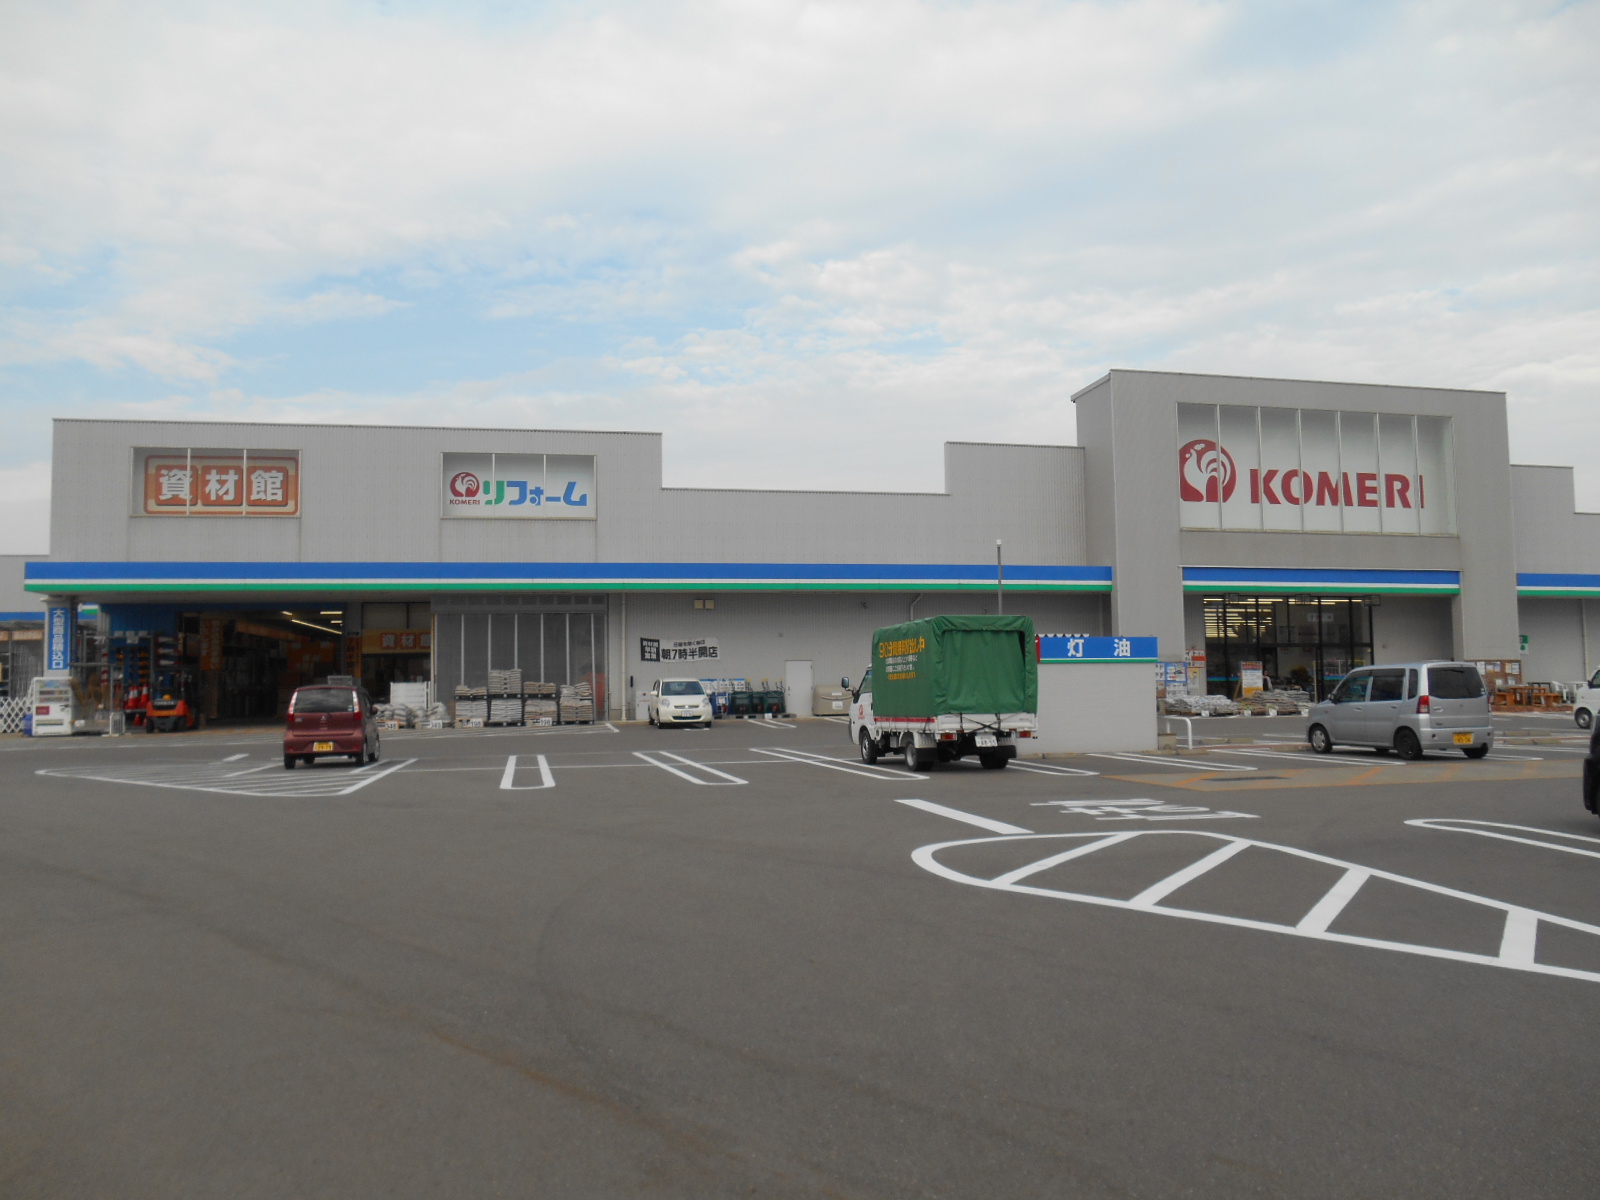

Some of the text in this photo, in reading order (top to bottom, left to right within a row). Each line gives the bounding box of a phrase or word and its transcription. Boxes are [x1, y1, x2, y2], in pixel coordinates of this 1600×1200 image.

[159, 469, 284, 502] 資材館
[483, 480, 588, 507] リフォーム
[1250, 468, 1425, 509] KOMERI
[661, 646, 718, 660] 朝7時半開店
